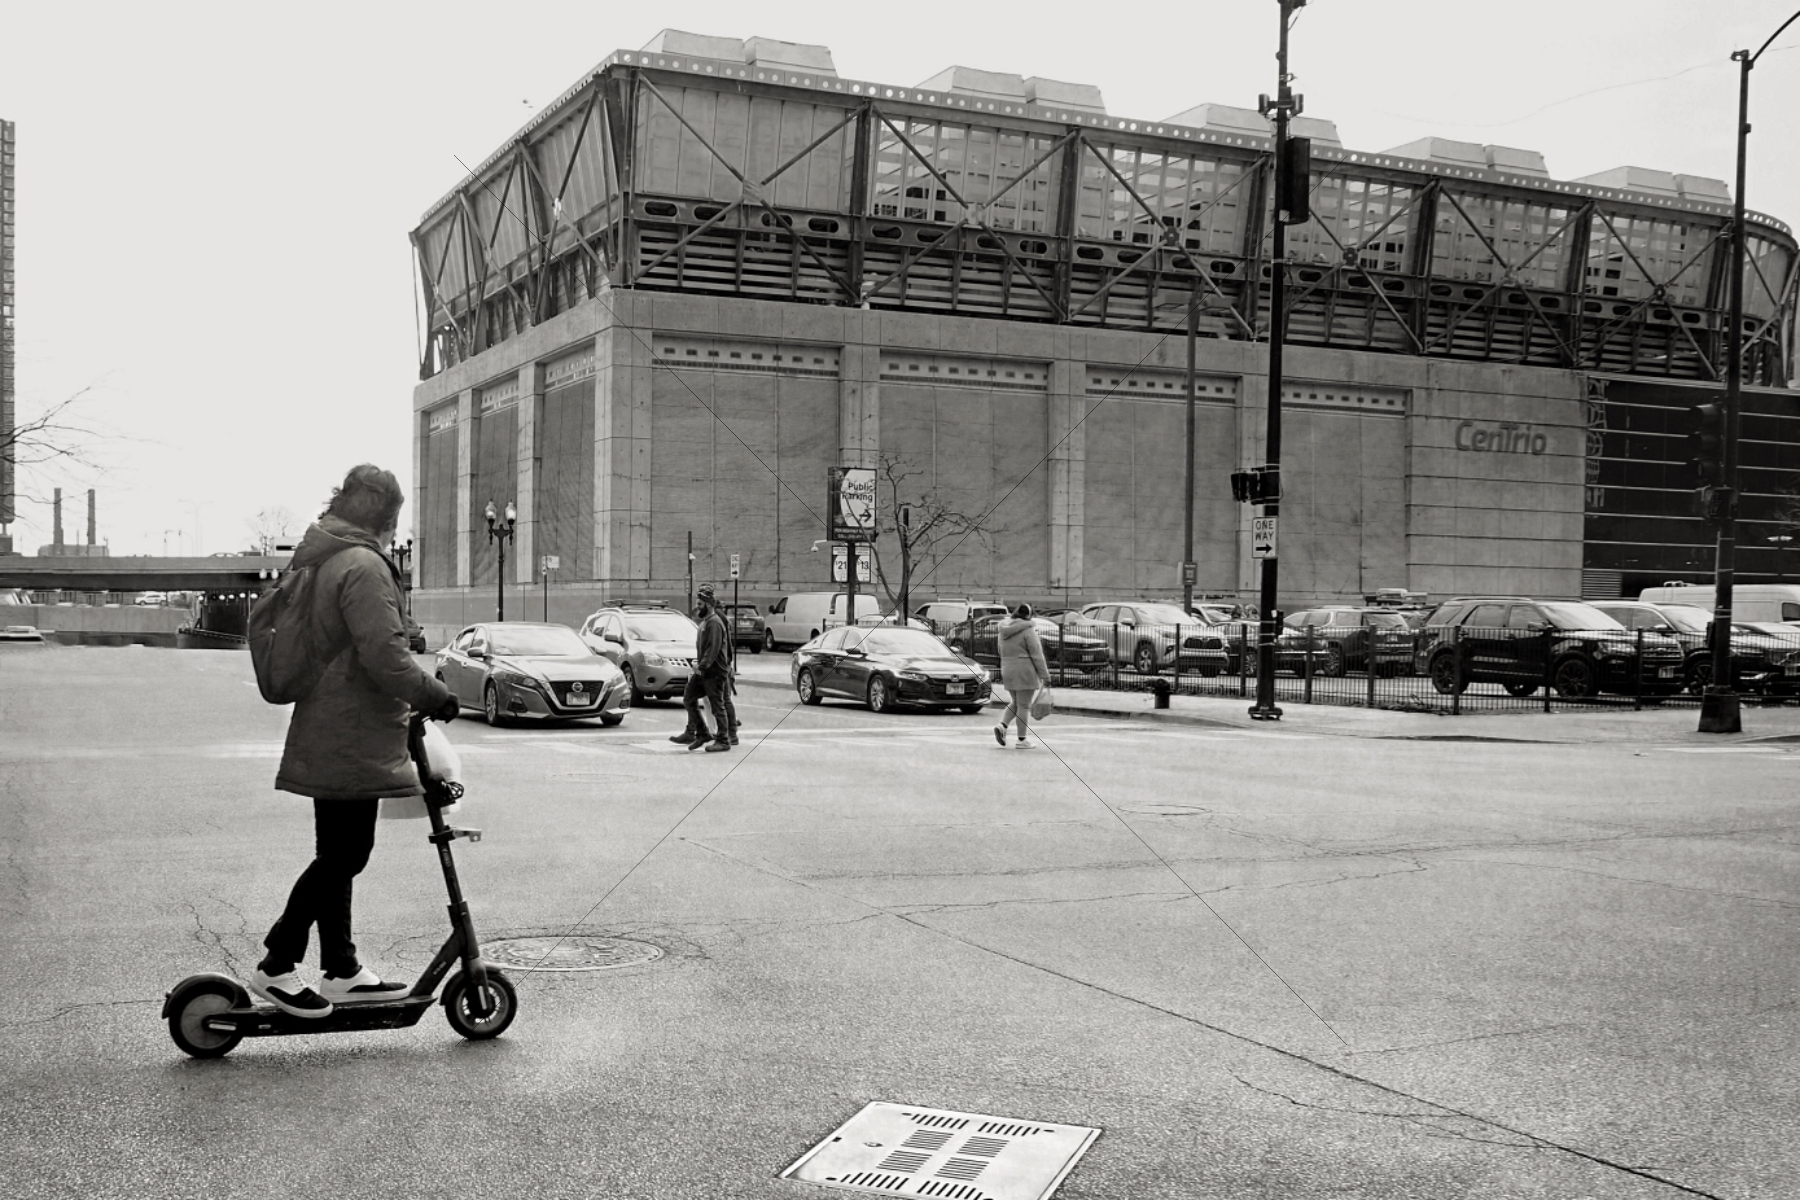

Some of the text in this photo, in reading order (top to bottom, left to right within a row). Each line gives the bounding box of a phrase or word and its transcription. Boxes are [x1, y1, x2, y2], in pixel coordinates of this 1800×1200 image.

[848, 482, 873, 491] Public
[1255, 520, 1274, 530] ONE
[1255, 531, 1274, 541] WAY
